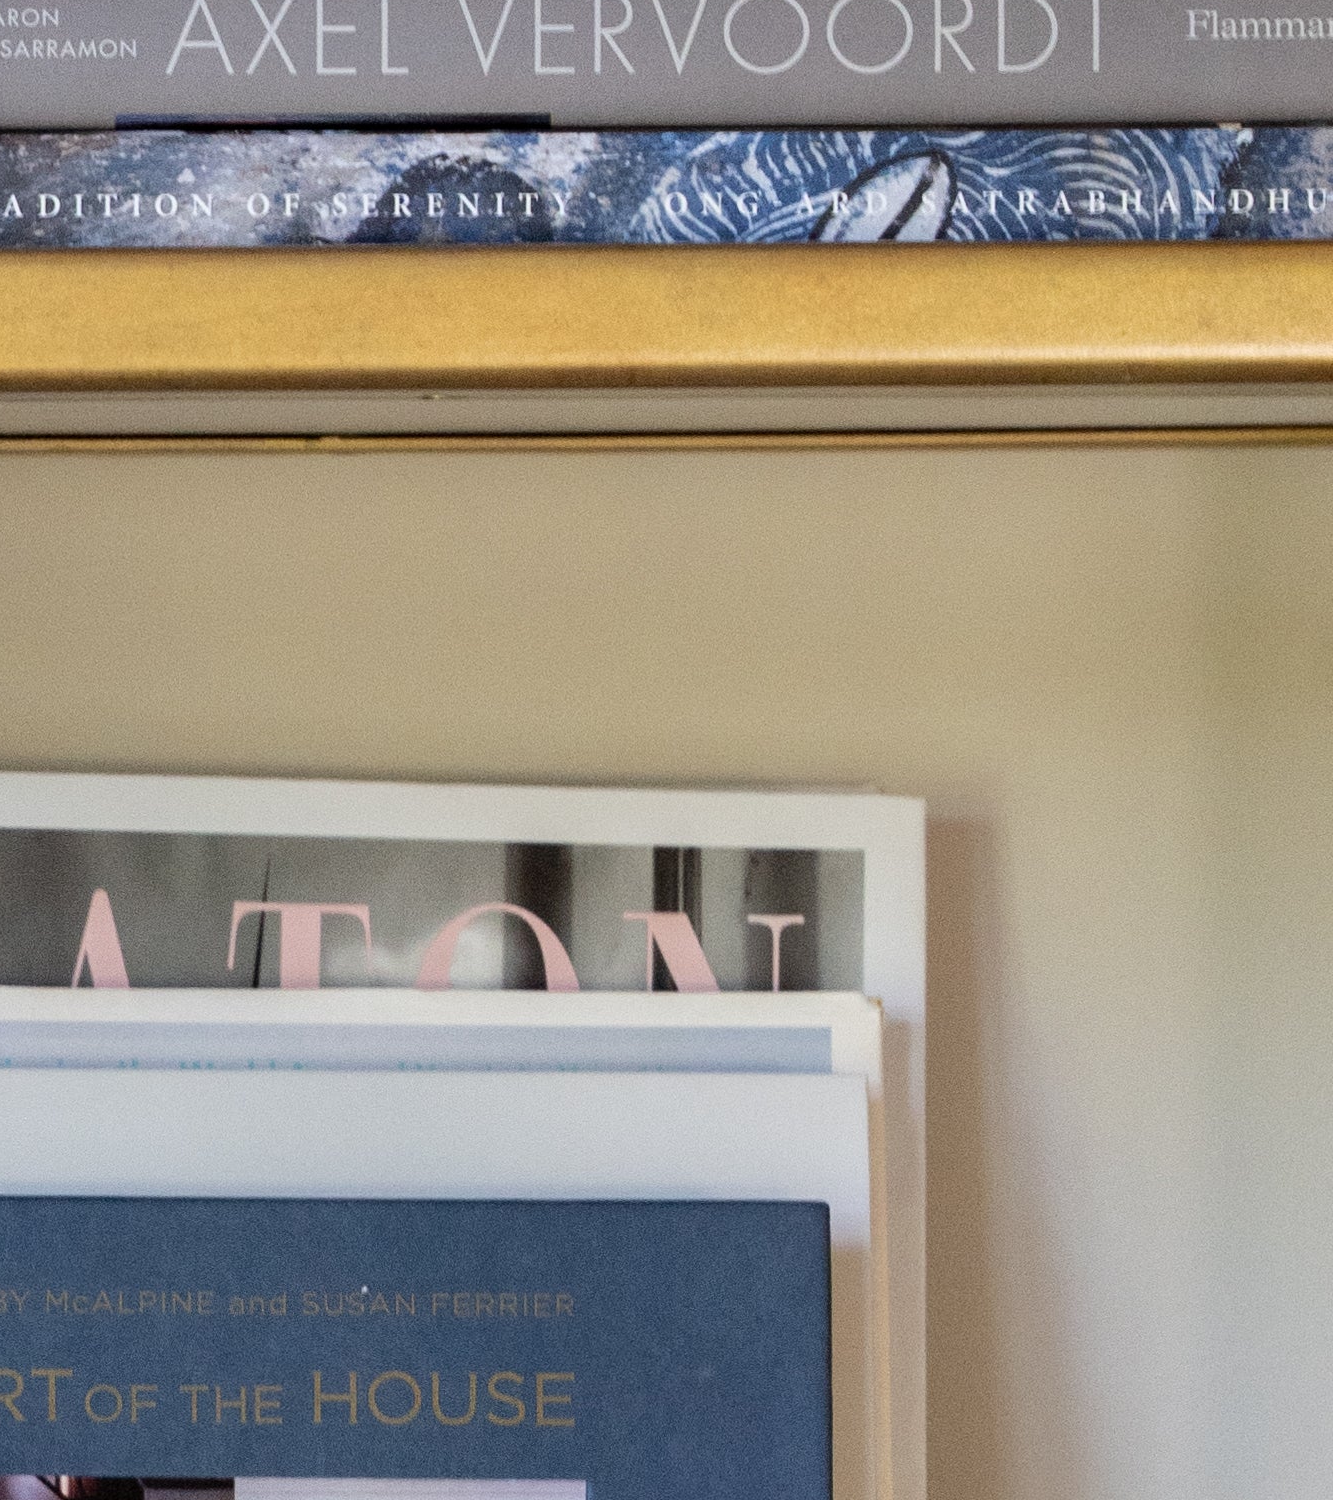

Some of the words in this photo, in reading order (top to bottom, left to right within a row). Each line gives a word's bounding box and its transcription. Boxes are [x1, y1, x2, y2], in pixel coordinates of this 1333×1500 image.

[0, 38, 138, 61] SARRAMON
[246, 191, 302, 217] OF
[332, 191, 575, 218] SERENITY
[921, 188, 1327, 215] SATRABHANDHU
[45, 1289, 215, 1316] McALPINE
[231, 1290, 287, 1316] and
[302, 1291, 417, 1317] SUSAN
[431, 1292, 576, 1318] FERRIER
[84, 1384, 159, 1424] OF
[179, 1385, 284, 1425] THE
[312, 1369, 576, 1427] HOUSE
